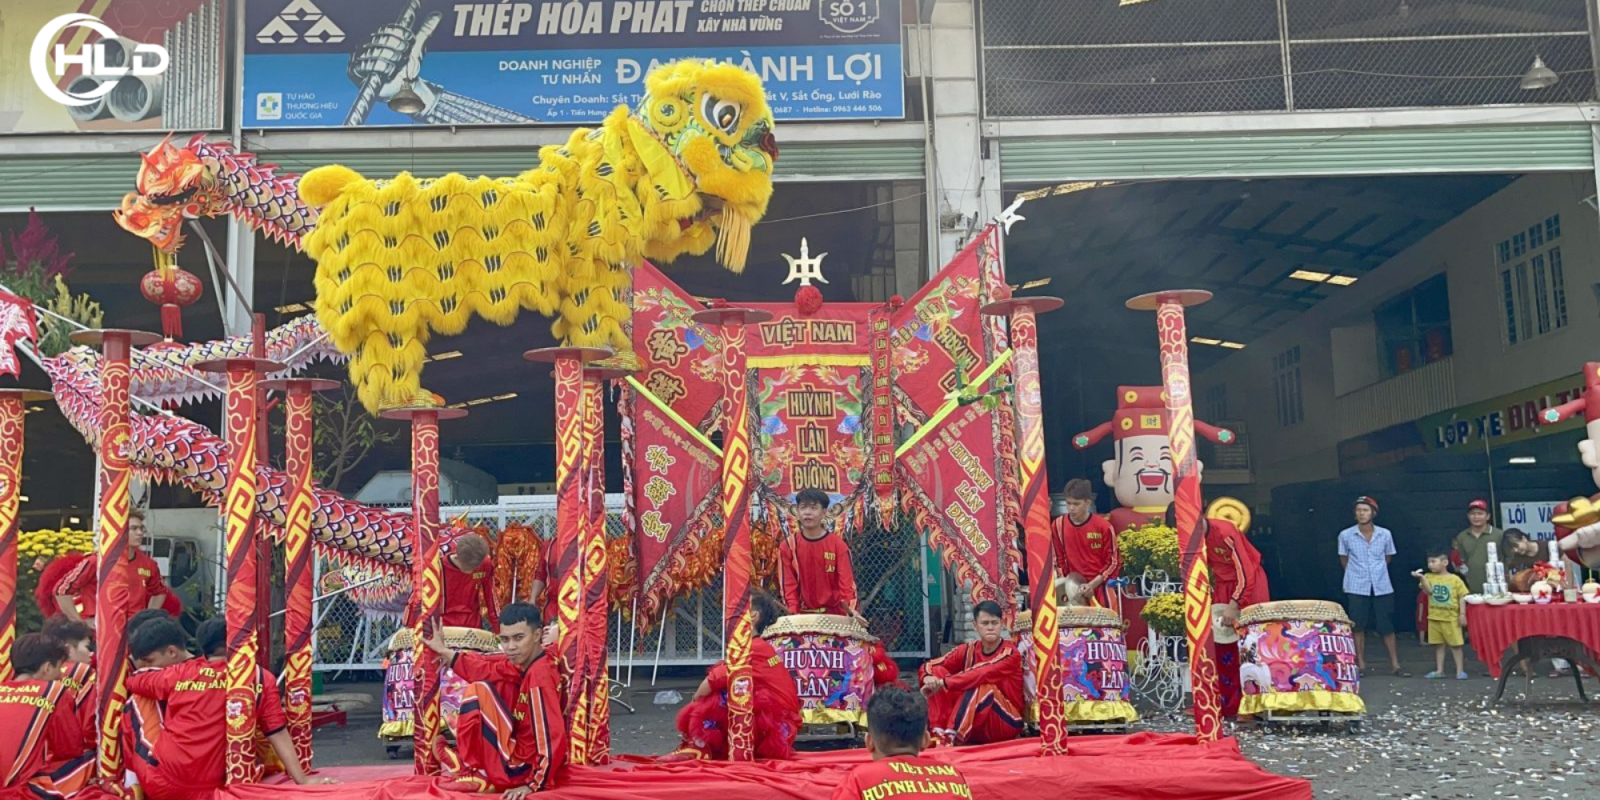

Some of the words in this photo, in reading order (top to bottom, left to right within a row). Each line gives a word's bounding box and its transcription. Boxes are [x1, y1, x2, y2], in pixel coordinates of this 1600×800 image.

[858, 2, 867, 15] 1
[697, 17, 721, 32] XÂY
[721, 16, 747, 32] NHÀ
[750, 15, 783, 31] VỮNG
[499, 61, 548, 71] DOANH
[552, 57, 602, 72] NGHIỆP
[827, 53, 882, 86] LỢI
[541, 74, 560, 85] TƯ
[562, 73, 602, 84] NHÂN
[532, 95, 570, 106] Chuyên
[573, 94, 609, 104] Doanh:
[863, 90, 882, 99] Rào
[763, 319, 806, 345] VIỆT
[812, 322, 853, 341] NAM
[790, 386, 832, 415] HUỲNH
[801, 423, 826, 453] LÂN
[794, 459, 836, 490] ĐƯỜNG
[784, 645, 845, 669] HUỲNH
[796, 672, 830, 697] LÂN
[924, 765, 959, 777] NAM
[917, 778, 949, 794] LÂN
